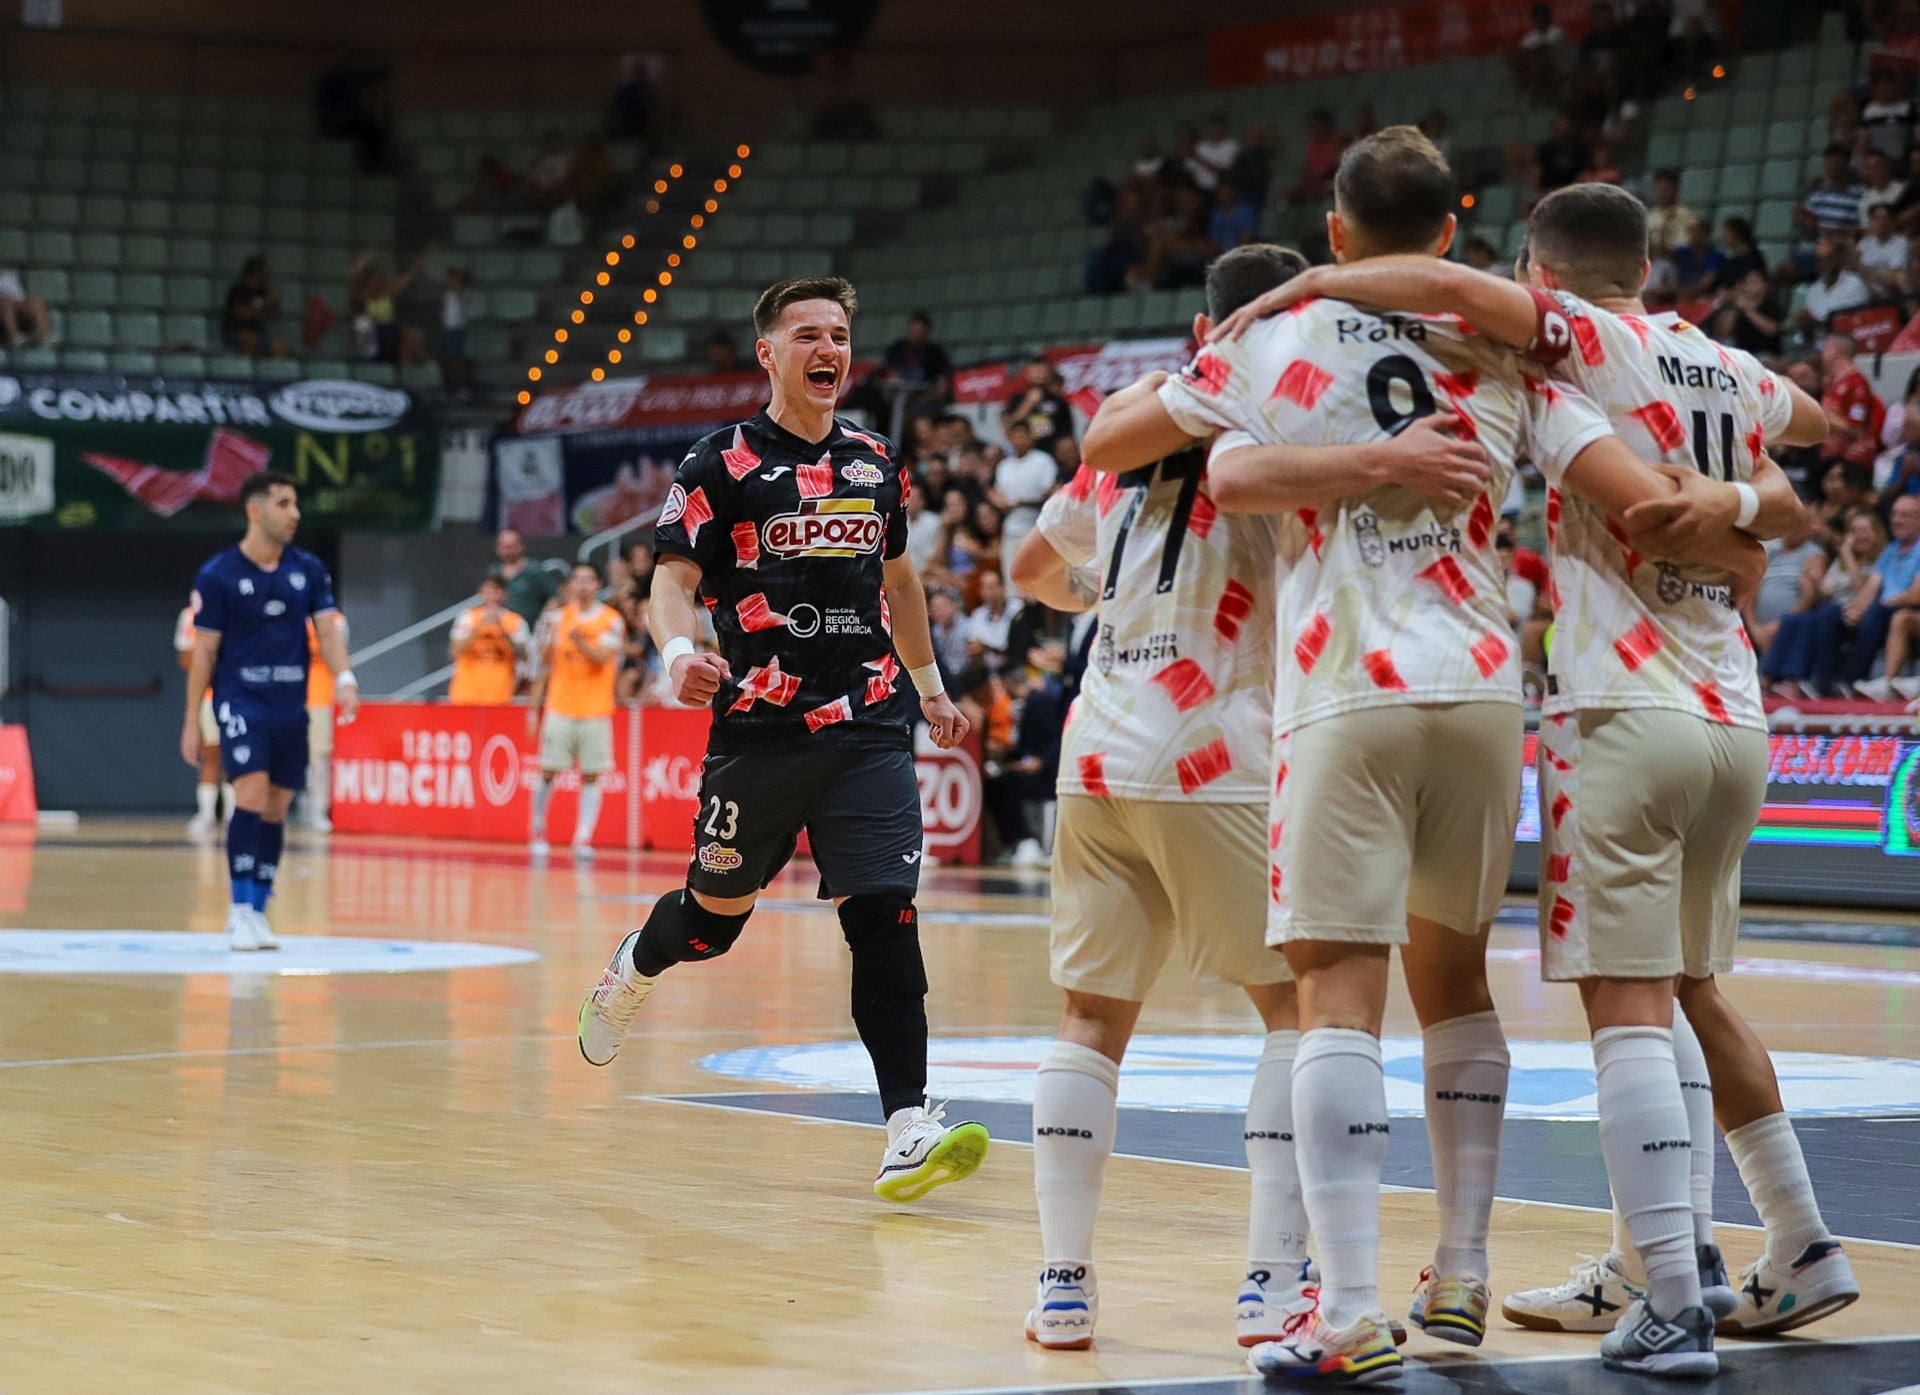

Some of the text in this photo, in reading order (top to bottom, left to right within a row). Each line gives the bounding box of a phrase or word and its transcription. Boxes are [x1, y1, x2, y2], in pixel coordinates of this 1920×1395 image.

[1337, 315, 1426, 343] Rafa
[29, 385, 271, 427] COMPARTIR
[825, 614, 860, 625] REGIÓN
[825, 625, 872, 634] DE MURCIA
[402, 729, 472, 762] 1200
[334, 760, 475, 808] MURCIA
[704, 795, 739, 840] 23
[1047, 1266, 1086, 1284] PRO
